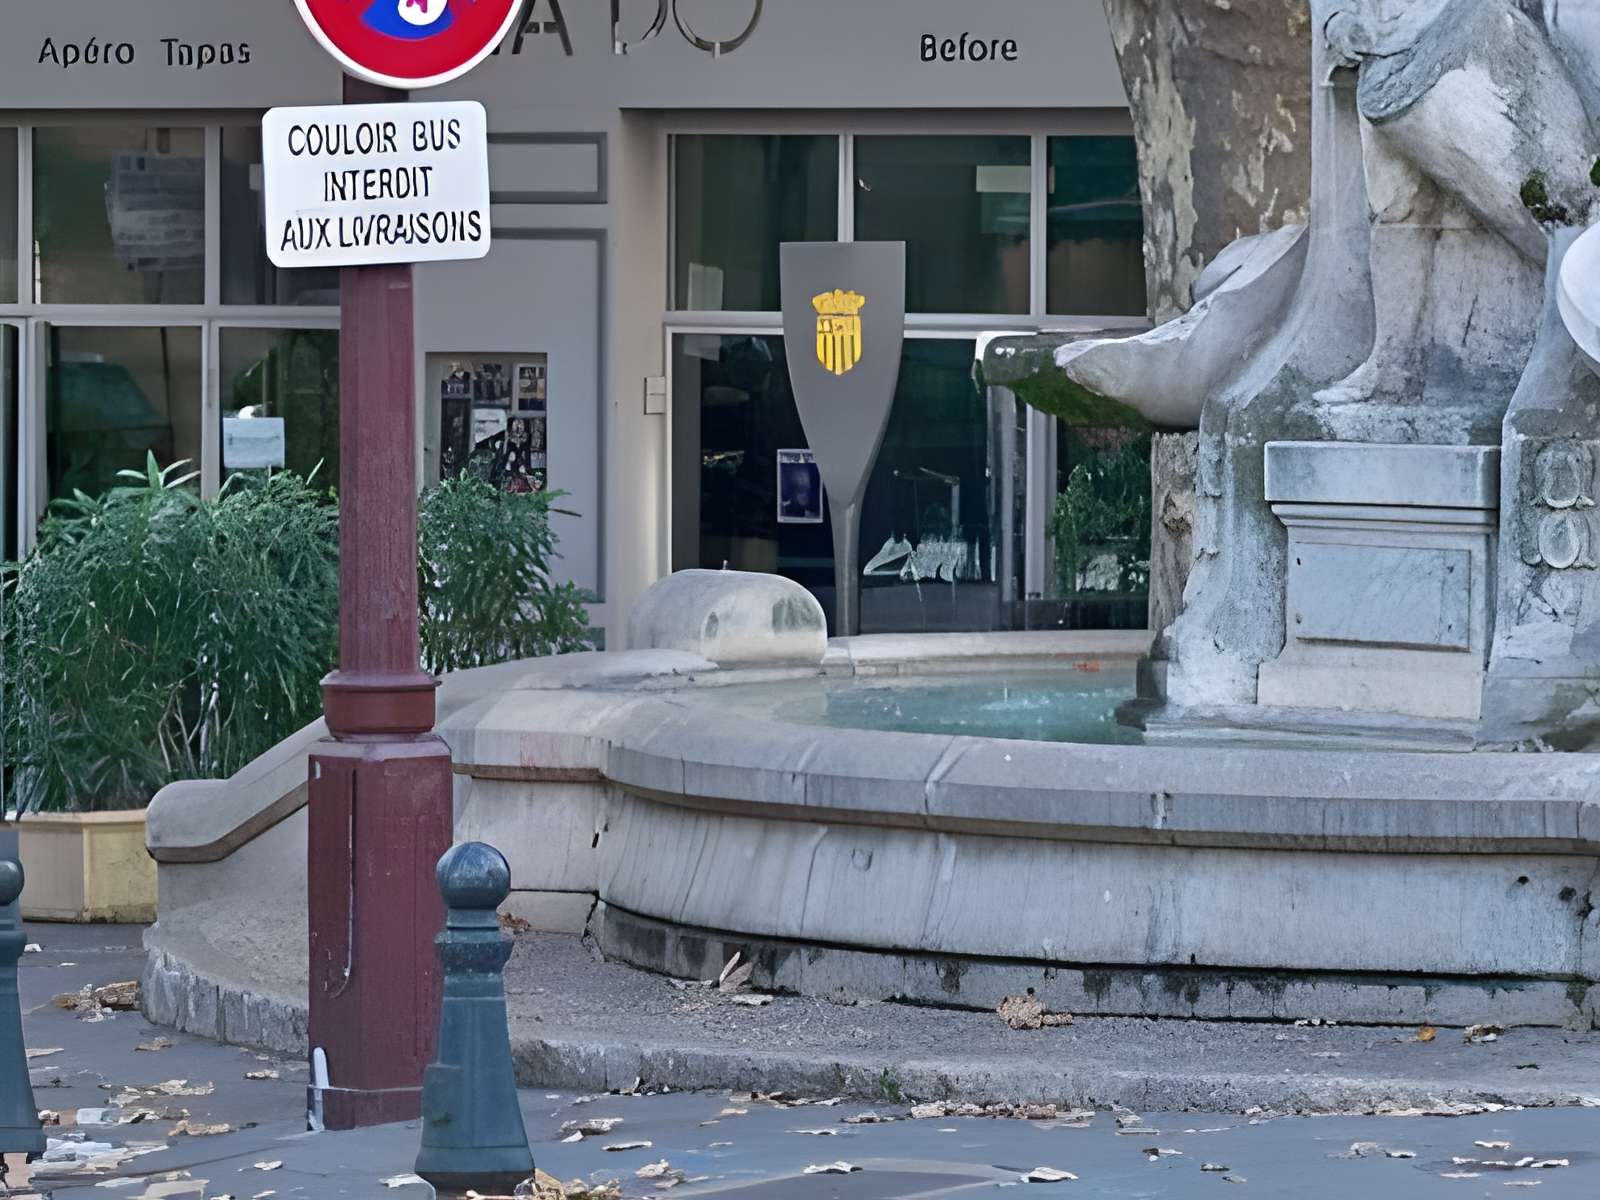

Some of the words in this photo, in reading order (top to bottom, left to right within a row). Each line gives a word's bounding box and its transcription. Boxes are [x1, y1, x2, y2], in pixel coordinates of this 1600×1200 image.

[38, 37, 135, 69] Apéro
[920, 32, 1018, 62] Before
[288, 121, 397, 156] COULOIR
[412, 119, 461, 152] BUS
[324, 166, 433, 202] INTERDIT
[280, 217, 332, 251] AUX
[338, 210, 482, 248] LIVRAISONS
